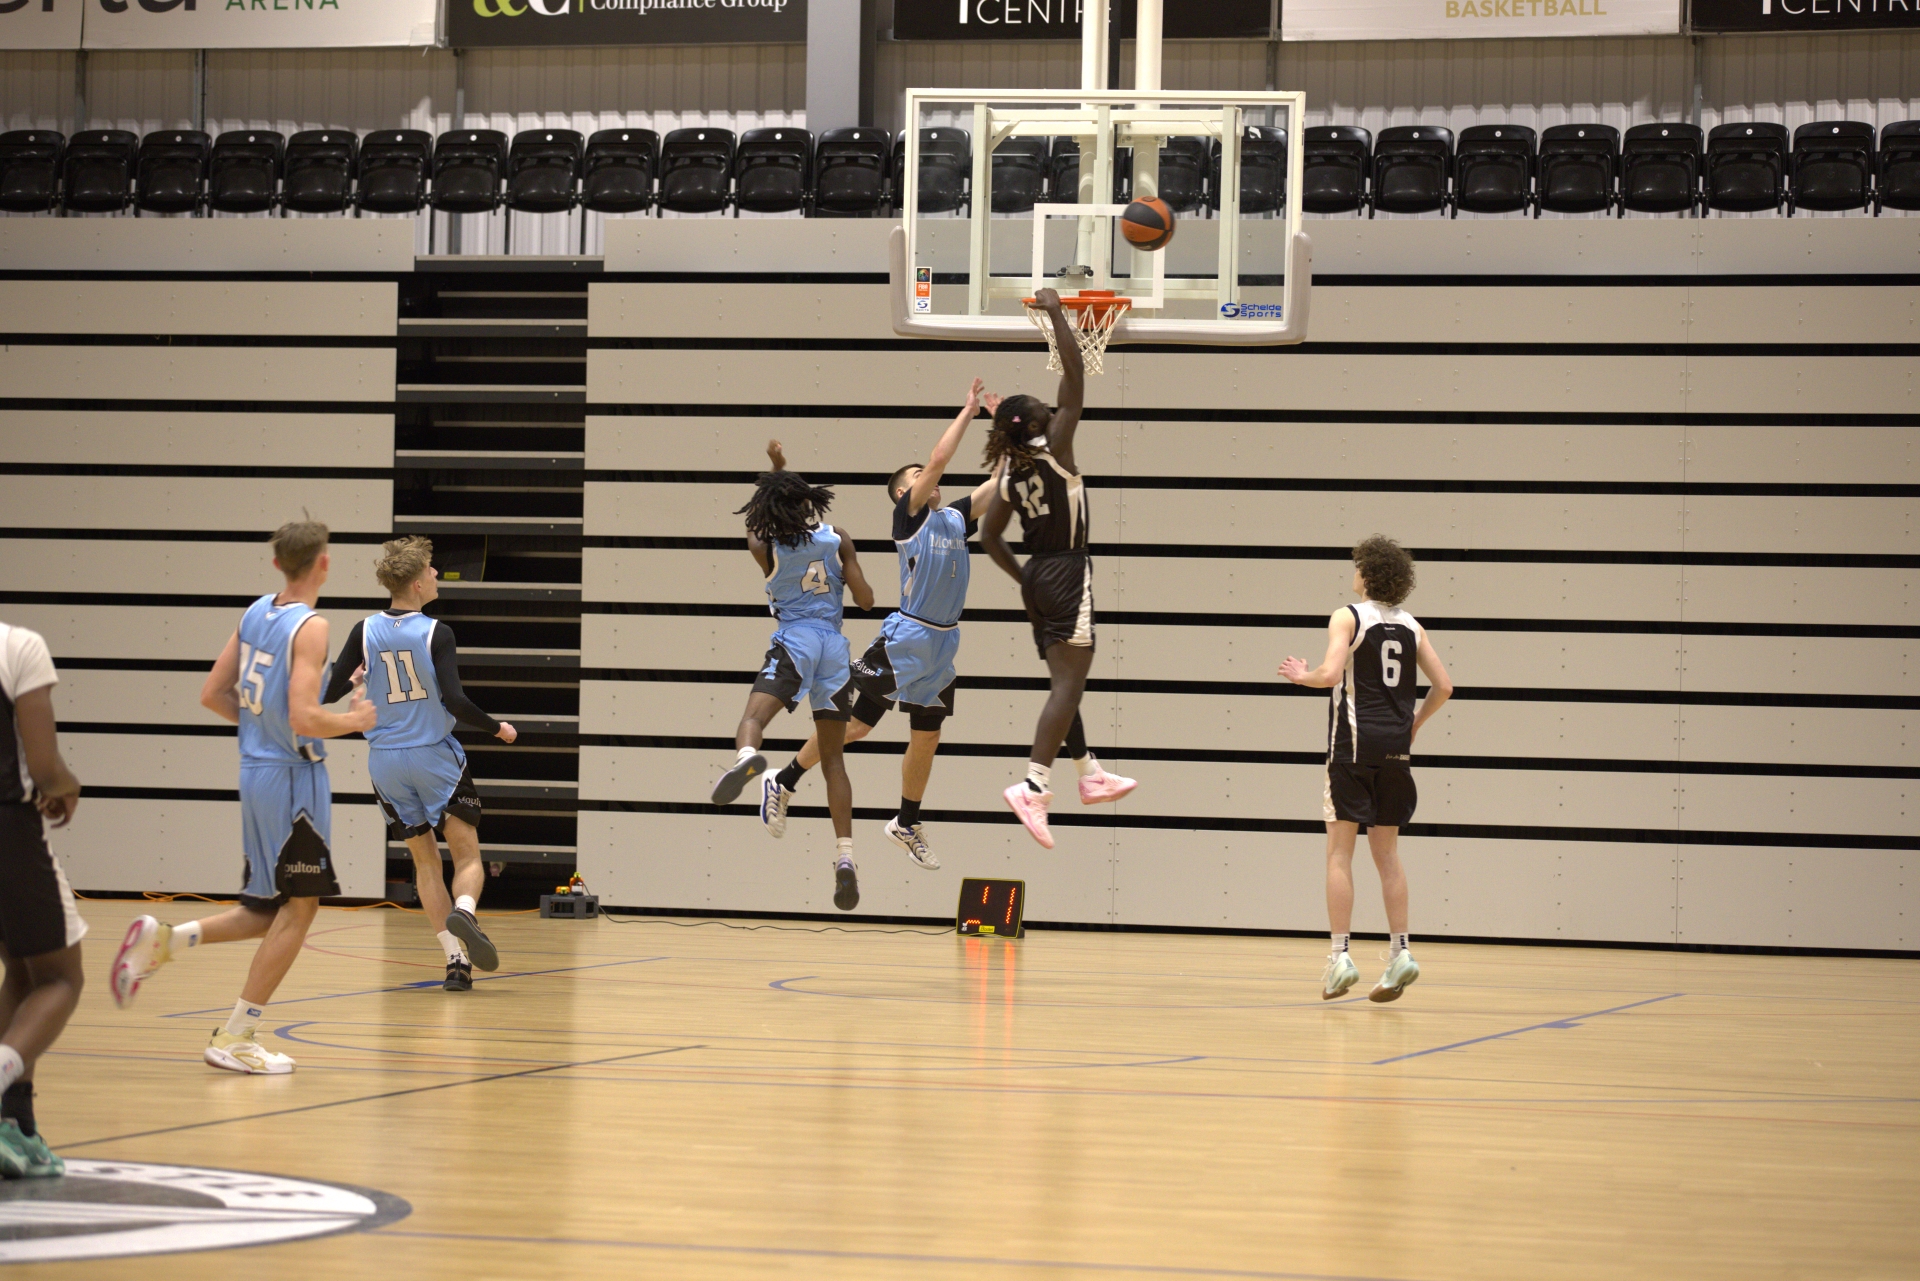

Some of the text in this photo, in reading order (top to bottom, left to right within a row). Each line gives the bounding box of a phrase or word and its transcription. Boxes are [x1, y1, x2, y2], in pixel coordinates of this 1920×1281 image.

[976, 0, 1112, 24] CENT
[1445, 0, 1607, 18] BASKETBALL
[1240, 303, 1282, 311] Schelde
[1240, 310, 1282, 319] Sports
[1014, 474, 1050, 519] 12
[800, 559, 831, 596] 4
[950, 559, 957, 578] 1
[1380, 639, 1403, 688] 6
[239, 640, 275, 716] 15
[379, 649, 429, 704] 11
[284, 861, 321, 874] oulton
